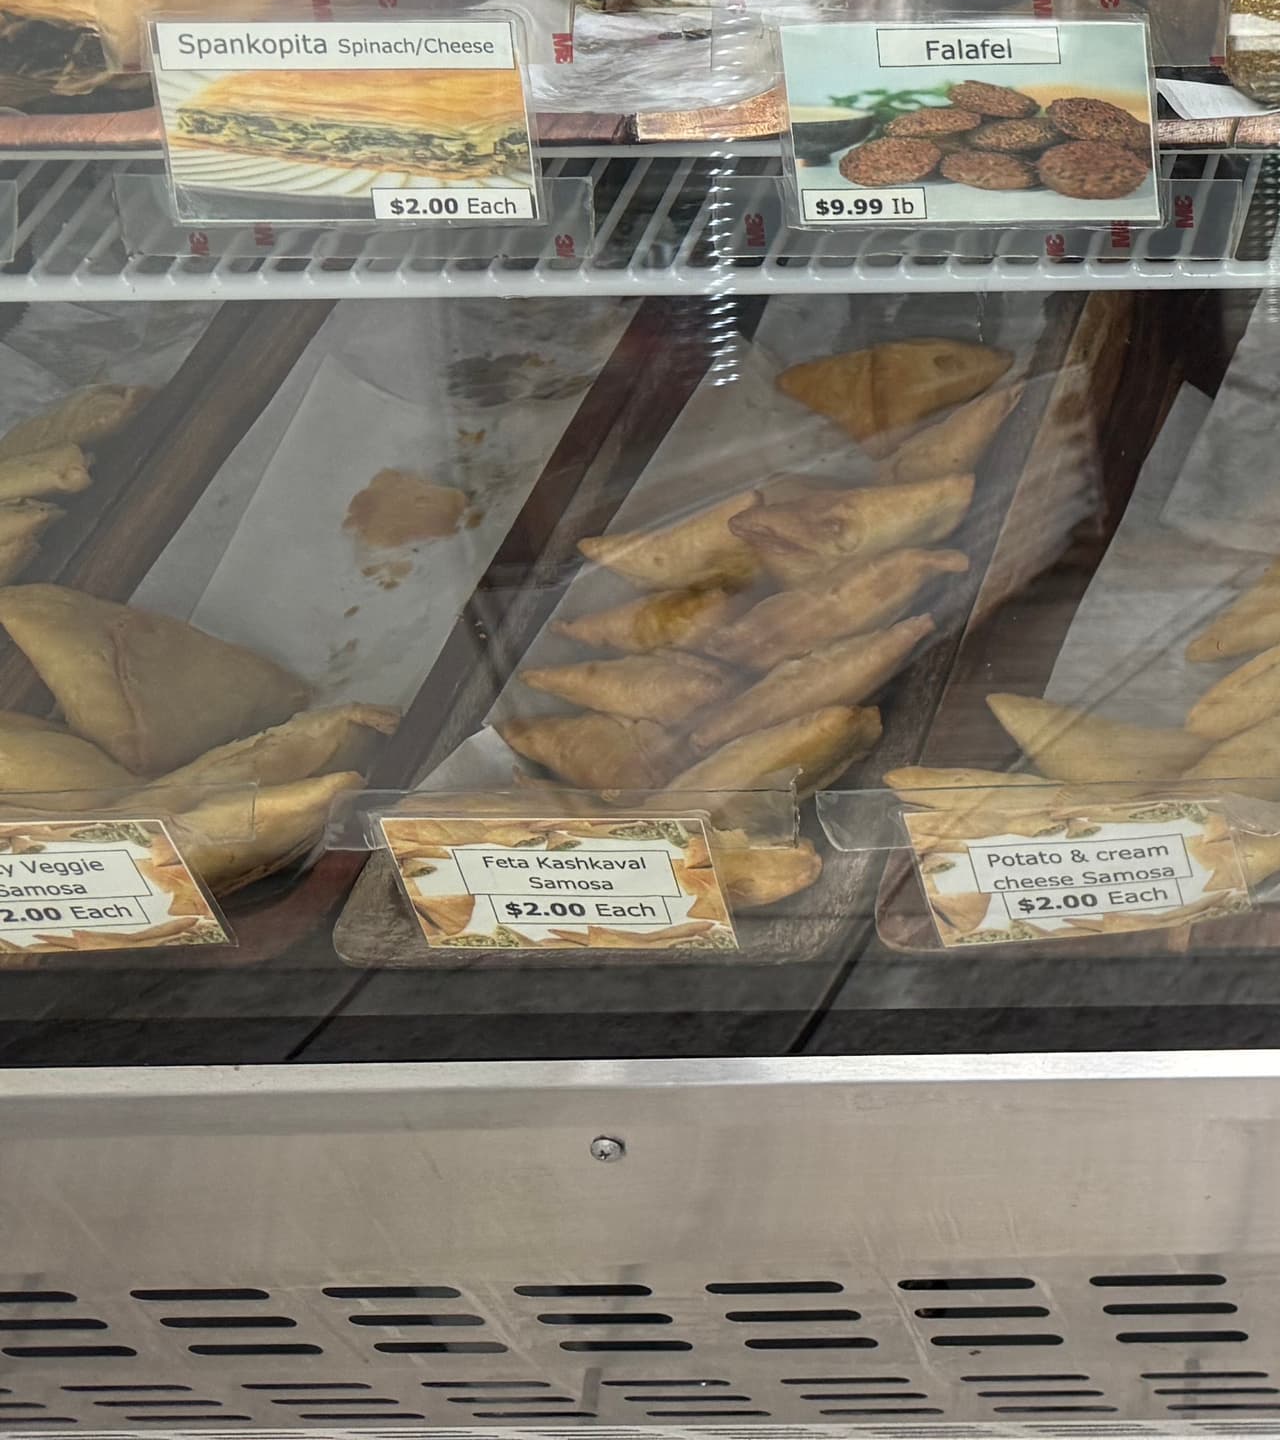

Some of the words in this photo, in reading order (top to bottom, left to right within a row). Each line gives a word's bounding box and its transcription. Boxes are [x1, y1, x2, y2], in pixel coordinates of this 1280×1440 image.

[179, 34, 327, 58] Spankopita
[338, 37, 494, 56] Spinach/Cheese
[926, 38, 1012, 60] Falafel
[390, 198, 458, 217] $2.00
[468, 198, 516, 214] Each
[815, 198, 882, 216] $9.99
[483, 856, 529, 869] Feta
[537, 857, 646, 870] Kashkaval
[987, 852, 1062, 868] Potato
[1070, 849, 1089, 863] &
[1096, 843, 1168, 861] cream
[0, 864, 13, 878] y
[19, 859, 104, 876] Veggie
[529, 876, 614, 890] Samosa
[993, 874, 1074, 891] cheese
[1082, 866, 1175, 884] Samosa
[0, 884, 88, 897] Samosa
[1018, 893, 1097, 912] $2.00
[1108, 887, 1168, 905] Each
[69, 904, 132, 920] Each
[506, 902, 586, 918] $2.00
[596, 903, 656, 918] Each
